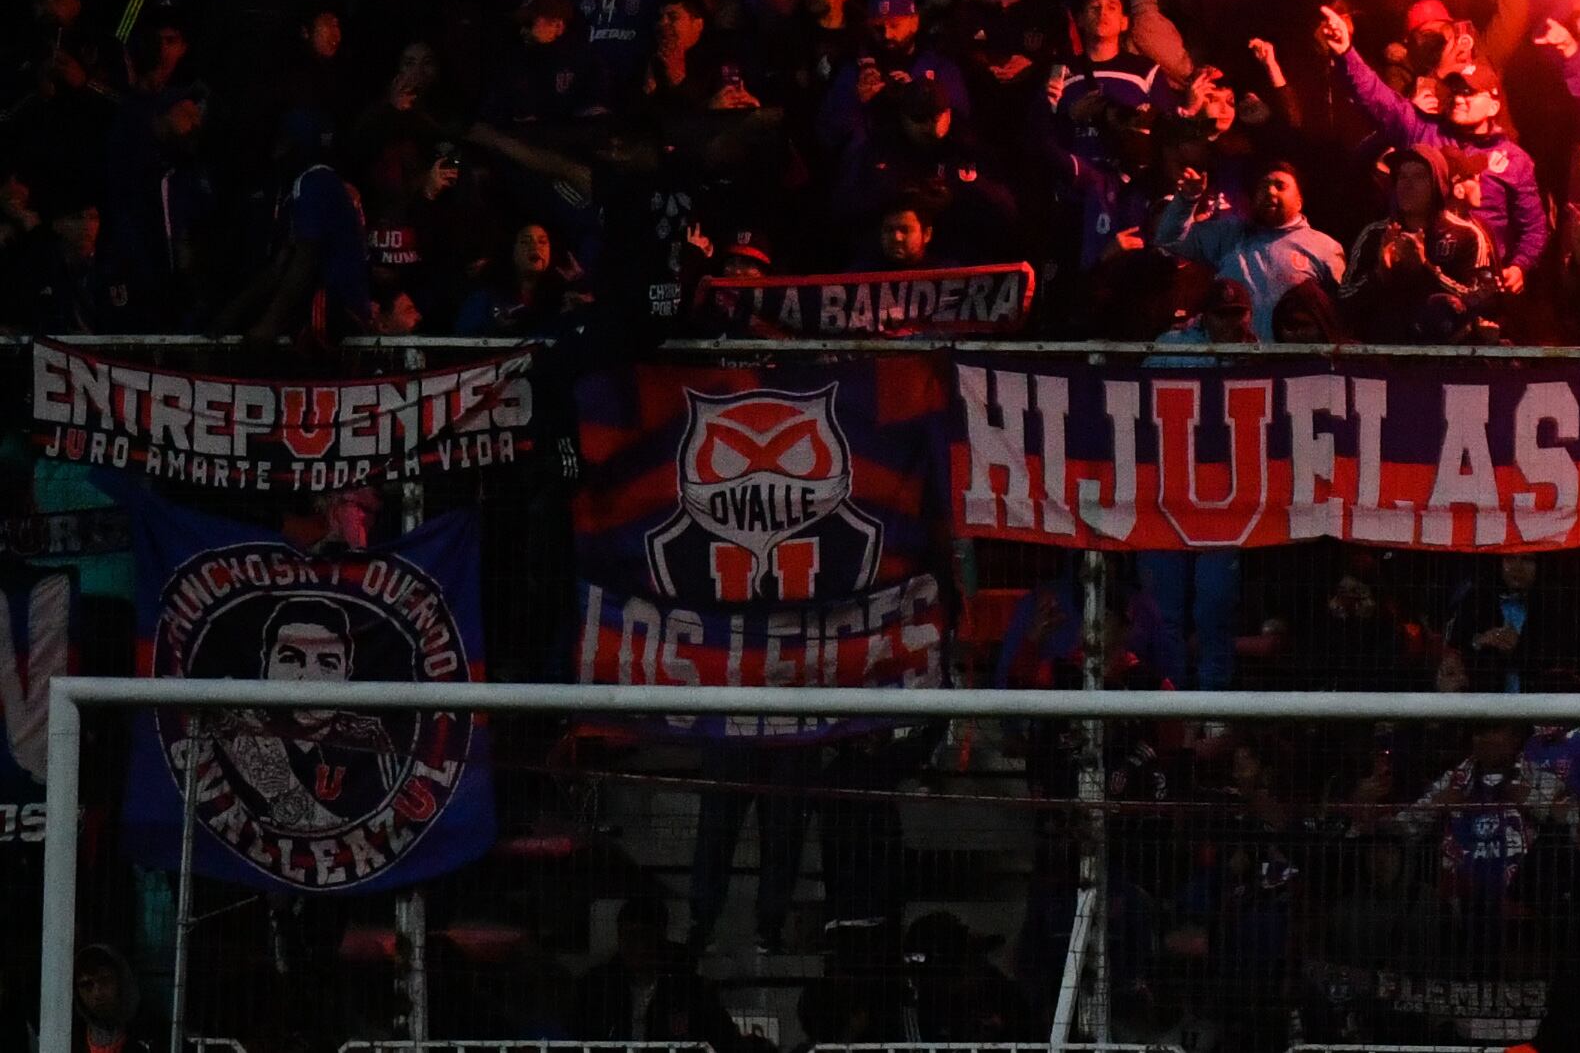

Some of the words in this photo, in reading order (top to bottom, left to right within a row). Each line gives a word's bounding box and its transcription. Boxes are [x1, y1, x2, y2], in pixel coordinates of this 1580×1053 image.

[819, 272, 1020, 334] BANDERA
[32, 346, 534, 458] ENTREPUENTES
[45, 431, 129, 469] JURO
[146, 451, 272, 490] AMARTE
[291, 457, 368, 492] TODA
[438, 429, 516, 466] VIDA
[956, 363, 1580, 546] HIJUELAS
[710, 484, 817, 532] OVALLE
